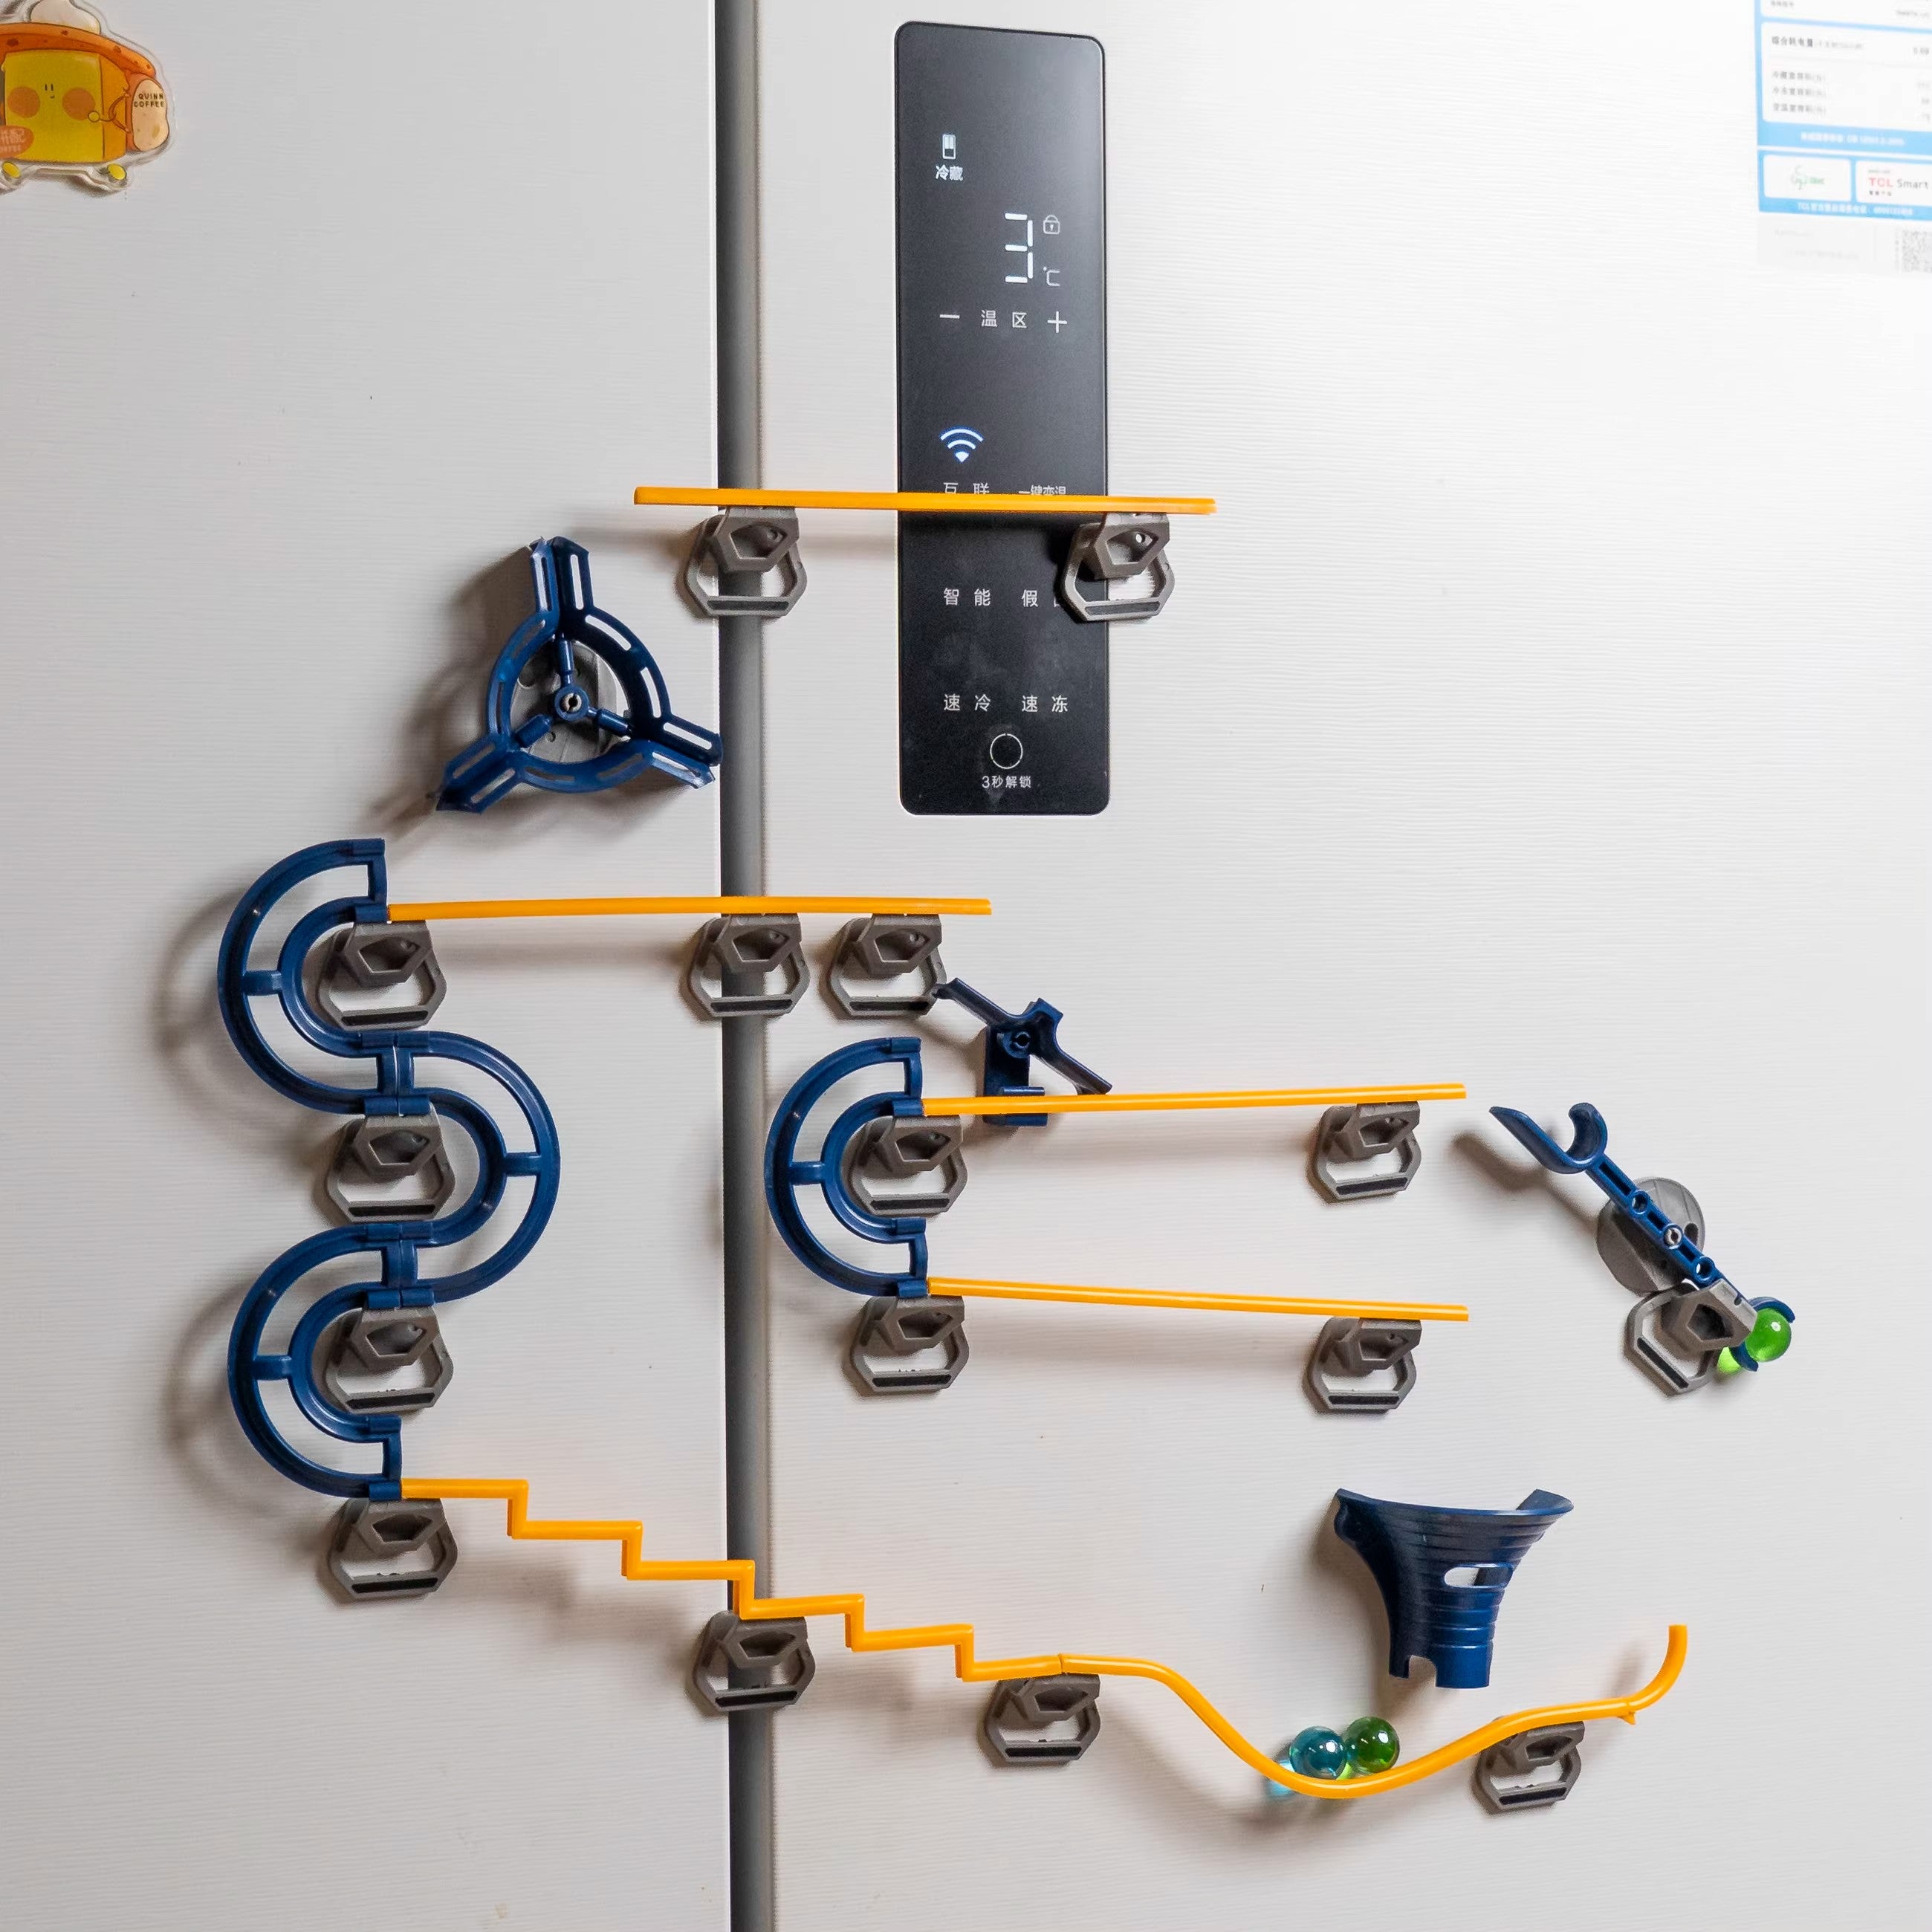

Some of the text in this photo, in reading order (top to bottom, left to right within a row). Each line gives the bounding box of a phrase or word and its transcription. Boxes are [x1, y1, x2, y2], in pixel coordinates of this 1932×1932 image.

[936, 165, 964, 181] 冷藏
[1868, 178, 1929, 189] TCL Smart
[1005, 213, 1034, 283] 3
[981, 310, 1028, 328] 温区
[944, 588, 991, 606] 智能
[944, 694, 991, 711] 速冷
[1022, 695, 1068, 713] 速冻
[982, 775, 1031, 789] 3秒解锁
